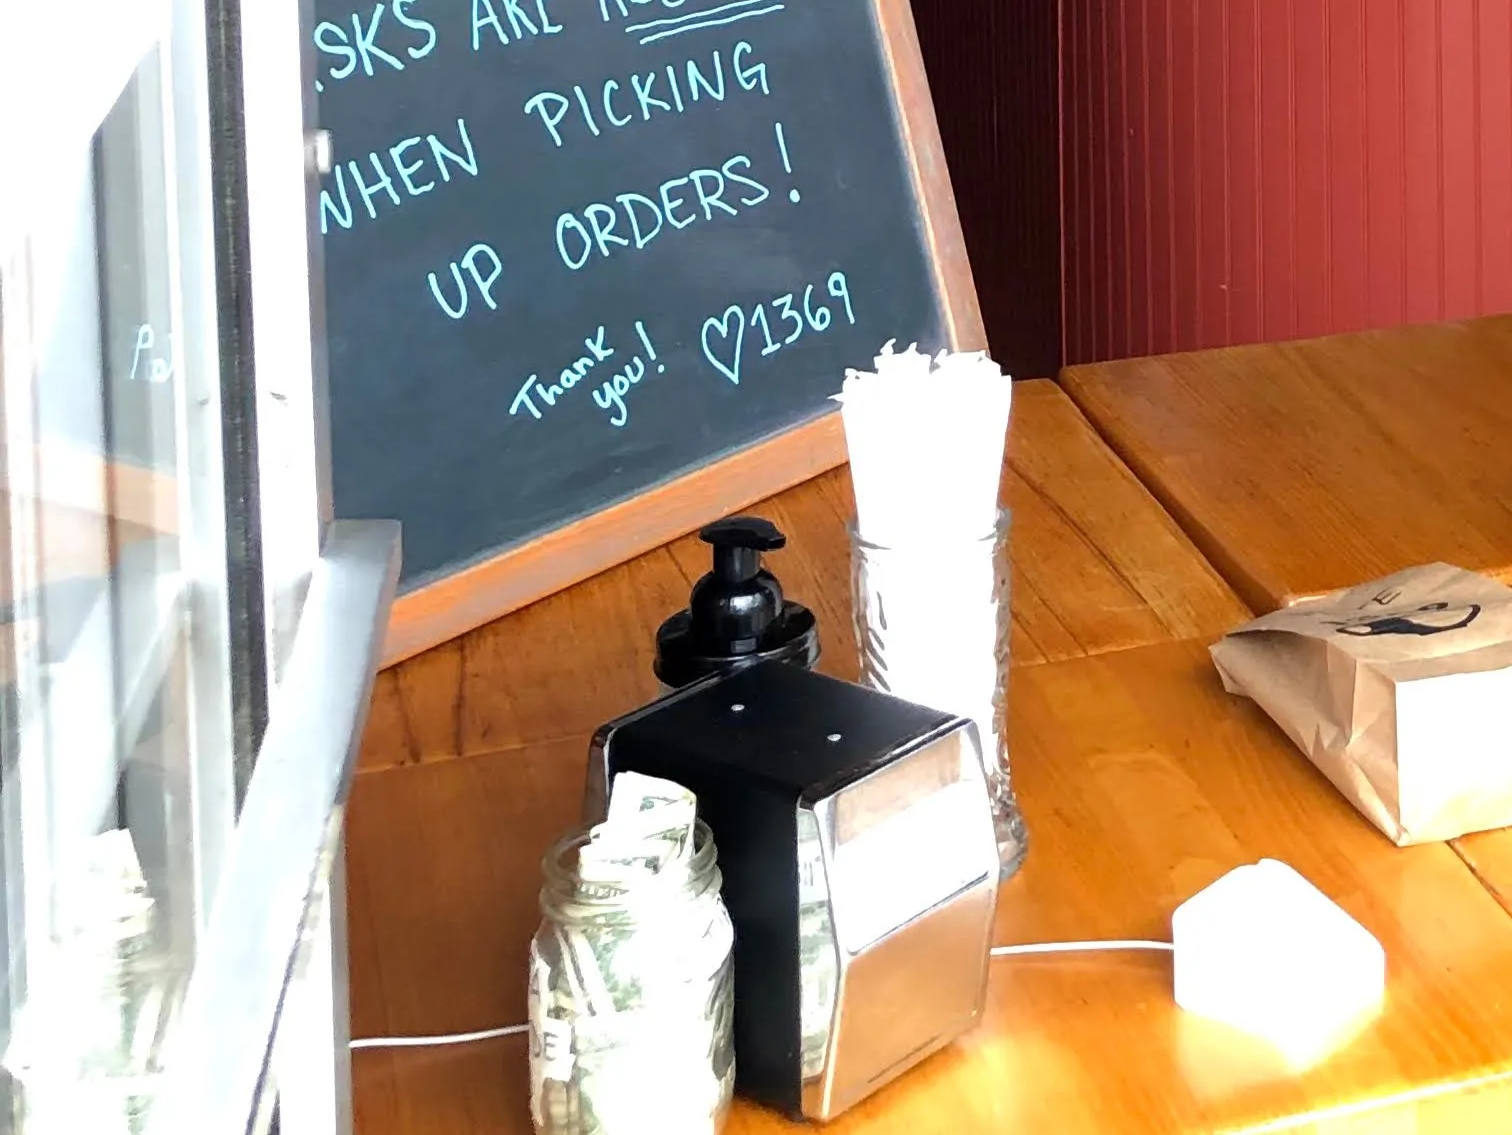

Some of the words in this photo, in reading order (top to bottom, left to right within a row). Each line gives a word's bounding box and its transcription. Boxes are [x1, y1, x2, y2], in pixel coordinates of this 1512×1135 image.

[524, 41, 771, 147] PICKING
[428, 243, 503, 320] UP
[555, 122, 802, 270] ORDERS!
[751, 271, 857, 357] 1369
[509, 325, 615, 421] Thank
[593, 321, 667, 427] you!
